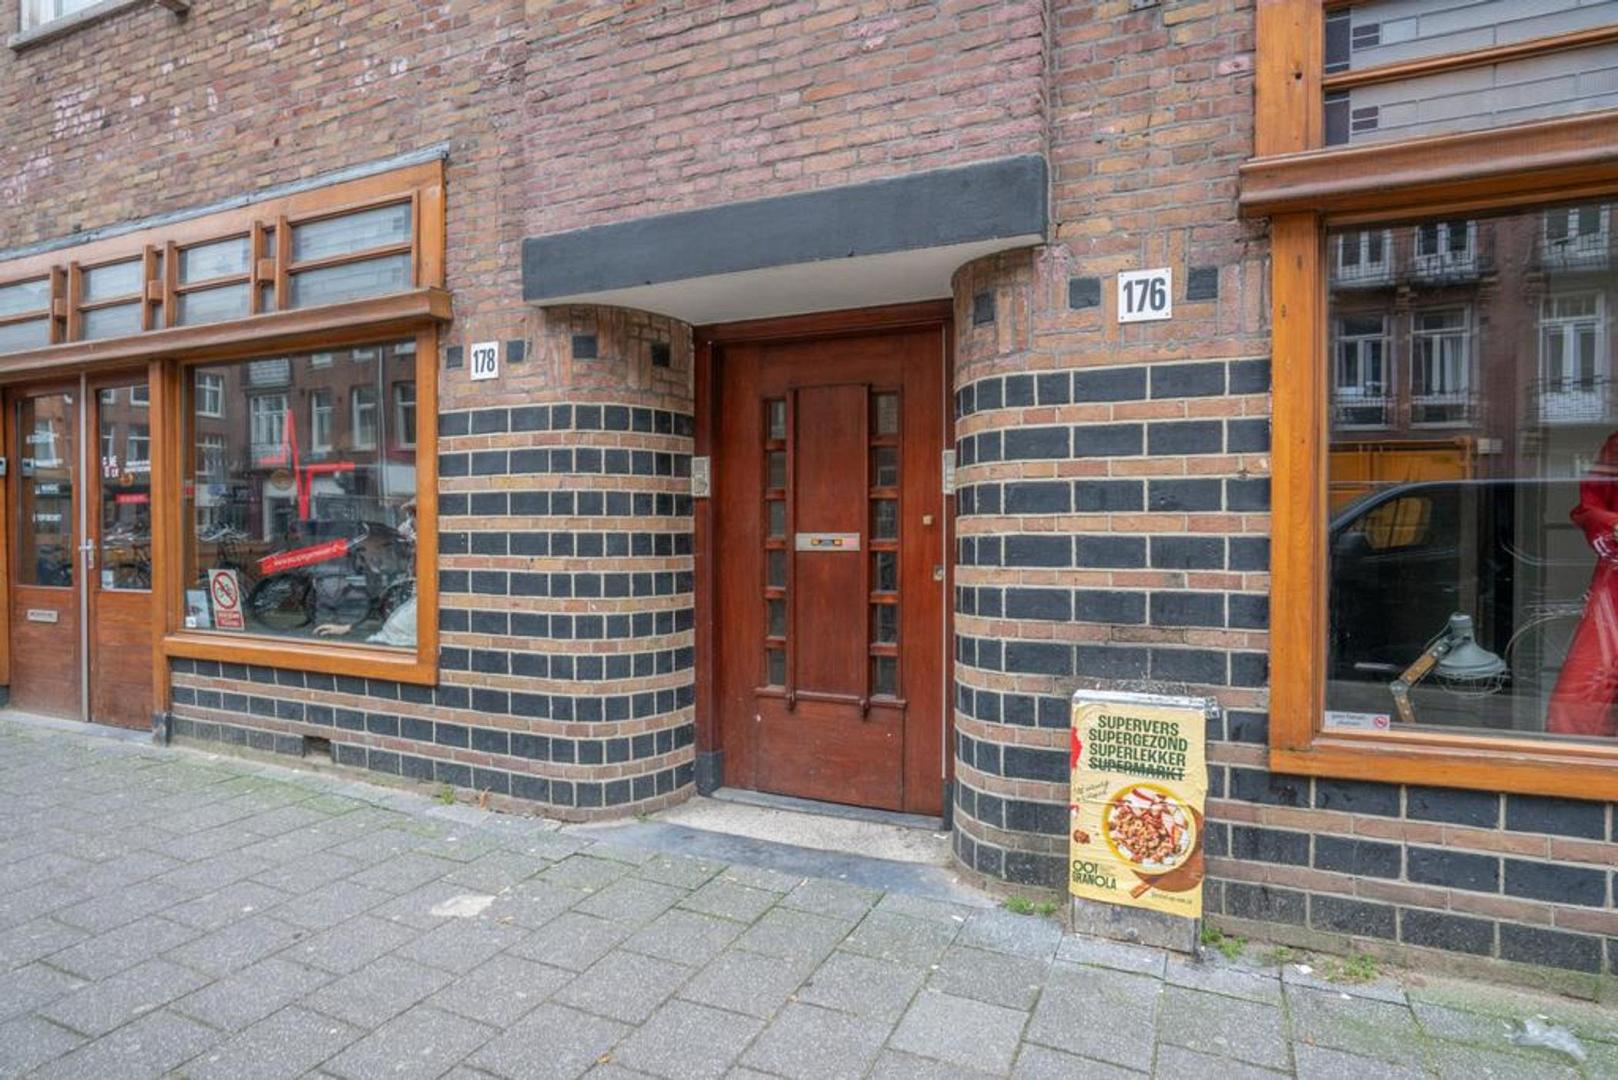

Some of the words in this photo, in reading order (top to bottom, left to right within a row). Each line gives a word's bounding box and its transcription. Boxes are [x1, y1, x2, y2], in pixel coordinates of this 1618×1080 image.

[1123, 277, 1166, 313] 176
[473, 348, 496, 373] 178
[1097, 715, 1179, 736] SUPERVERS
[1088, 728, 1188, 752] SUPERGEZOND
[1089, 742, 1186, 767] SUPERLEKKER
[1072, 871, 1117, 890] GRANOLA
